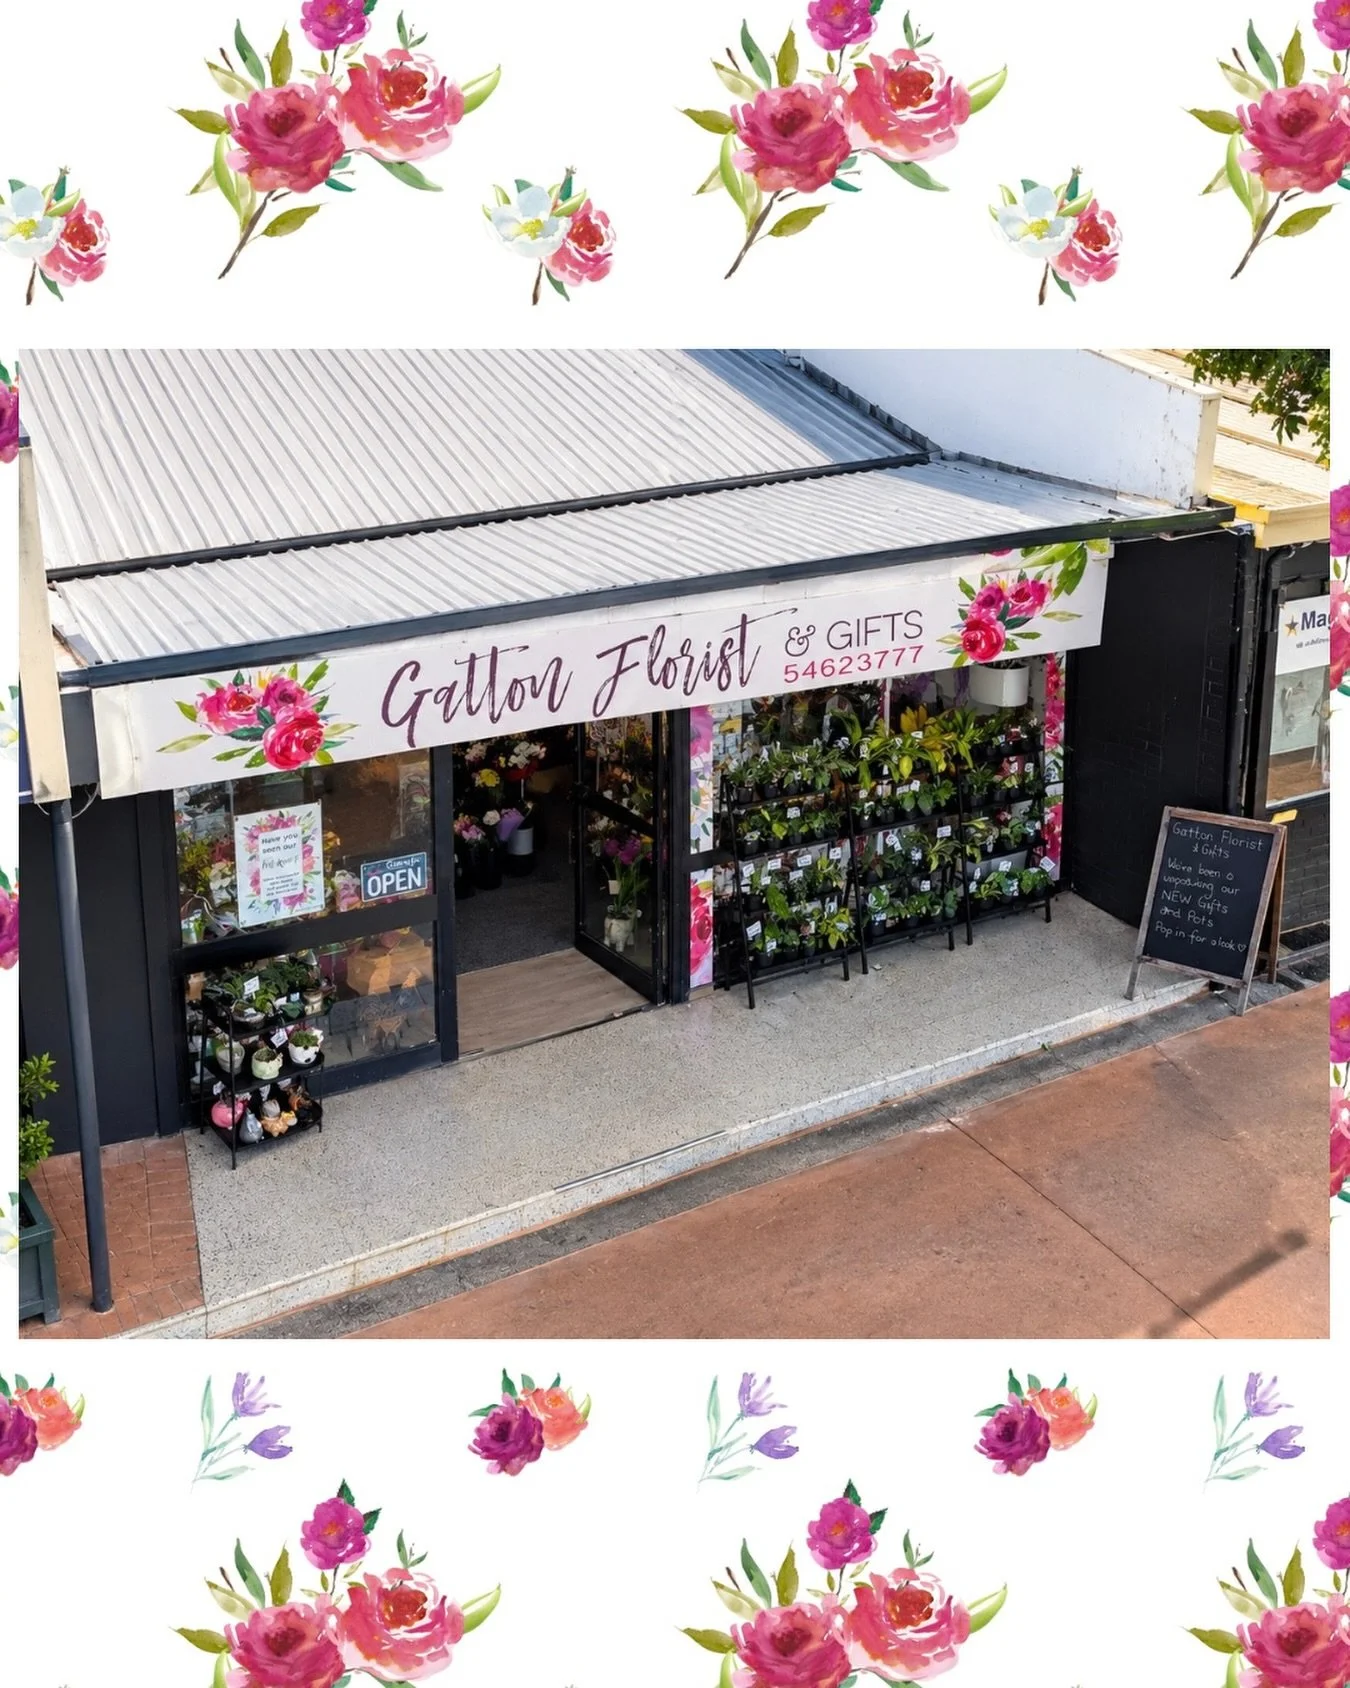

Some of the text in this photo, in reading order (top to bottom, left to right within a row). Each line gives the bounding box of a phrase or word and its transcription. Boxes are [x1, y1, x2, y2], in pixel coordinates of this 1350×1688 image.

[1301, 610, 1330, 631] Ma
[382, 607, 924, 748] Gatton Florist & GIFTS
[784, 645, 924, 684] 54623777
[283, 832, 299, 842] you
[1172, 822, 1264, 851] Gatton Florist
[1201, 843, 1230, 859] Gifts
[367, 867, 422, 897] OPEN
[1221, 886, 1240, 896] our
[1161, 889, 1228, 915] NEW Gifts
[1160, 906, 1213, 927] and Pots
[1155, 921, 1173, 938] Pop
[1175, 926, 1186, 938] in
[1189, 929, 1206, 945] for
[1218, 937, 1235, 951] look
